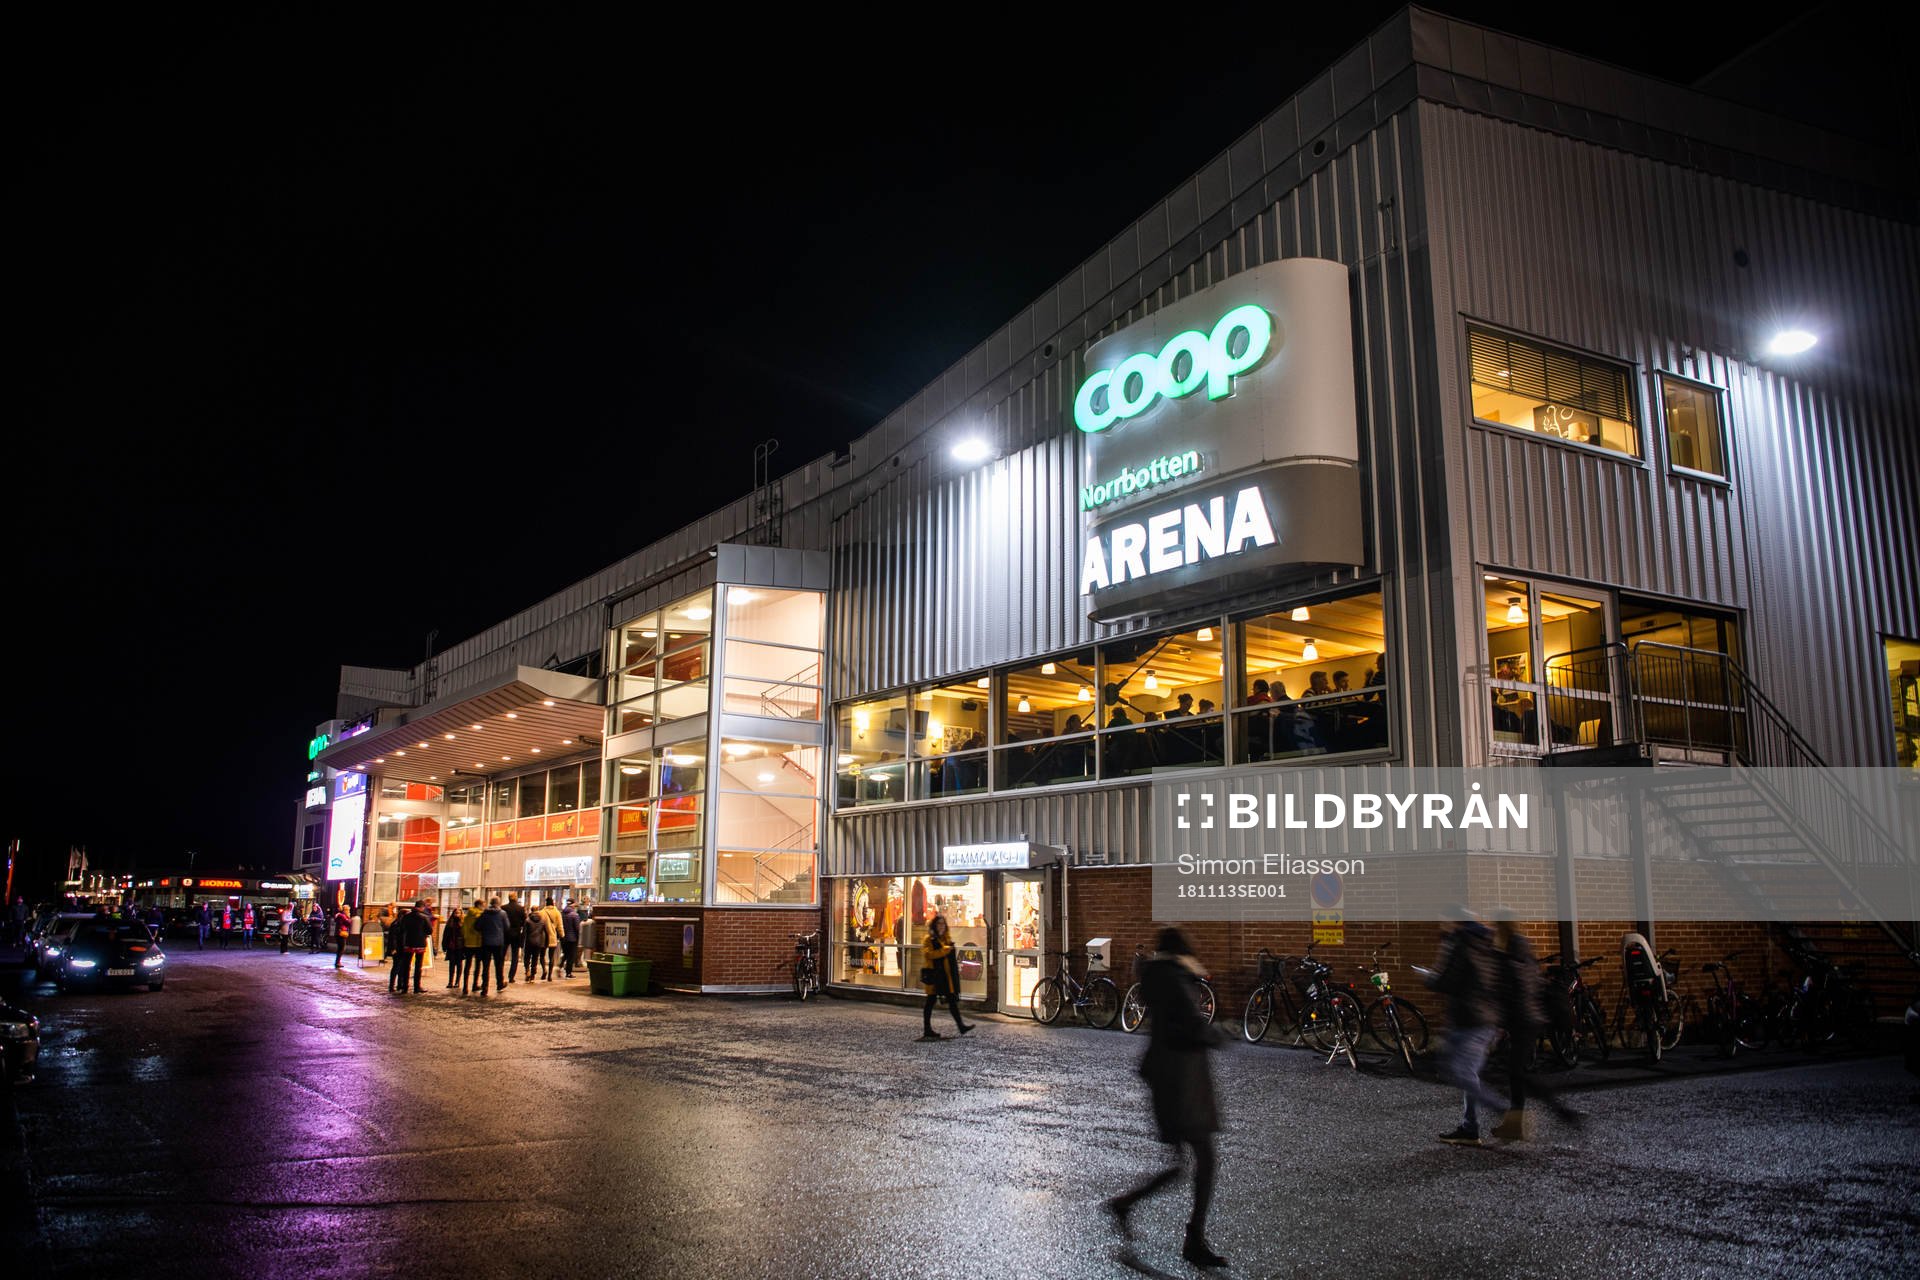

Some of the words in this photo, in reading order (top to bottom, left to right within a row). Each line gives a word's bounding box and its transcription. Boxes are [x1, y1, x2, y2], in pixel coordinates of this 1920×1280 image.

[1074, 305, 1271, 433] coop
[1079, 450, 1199, 513] Norrbotten
[1080, 486, 1276, 596] ARENA
[199, 879, 242, 888] HONDA
